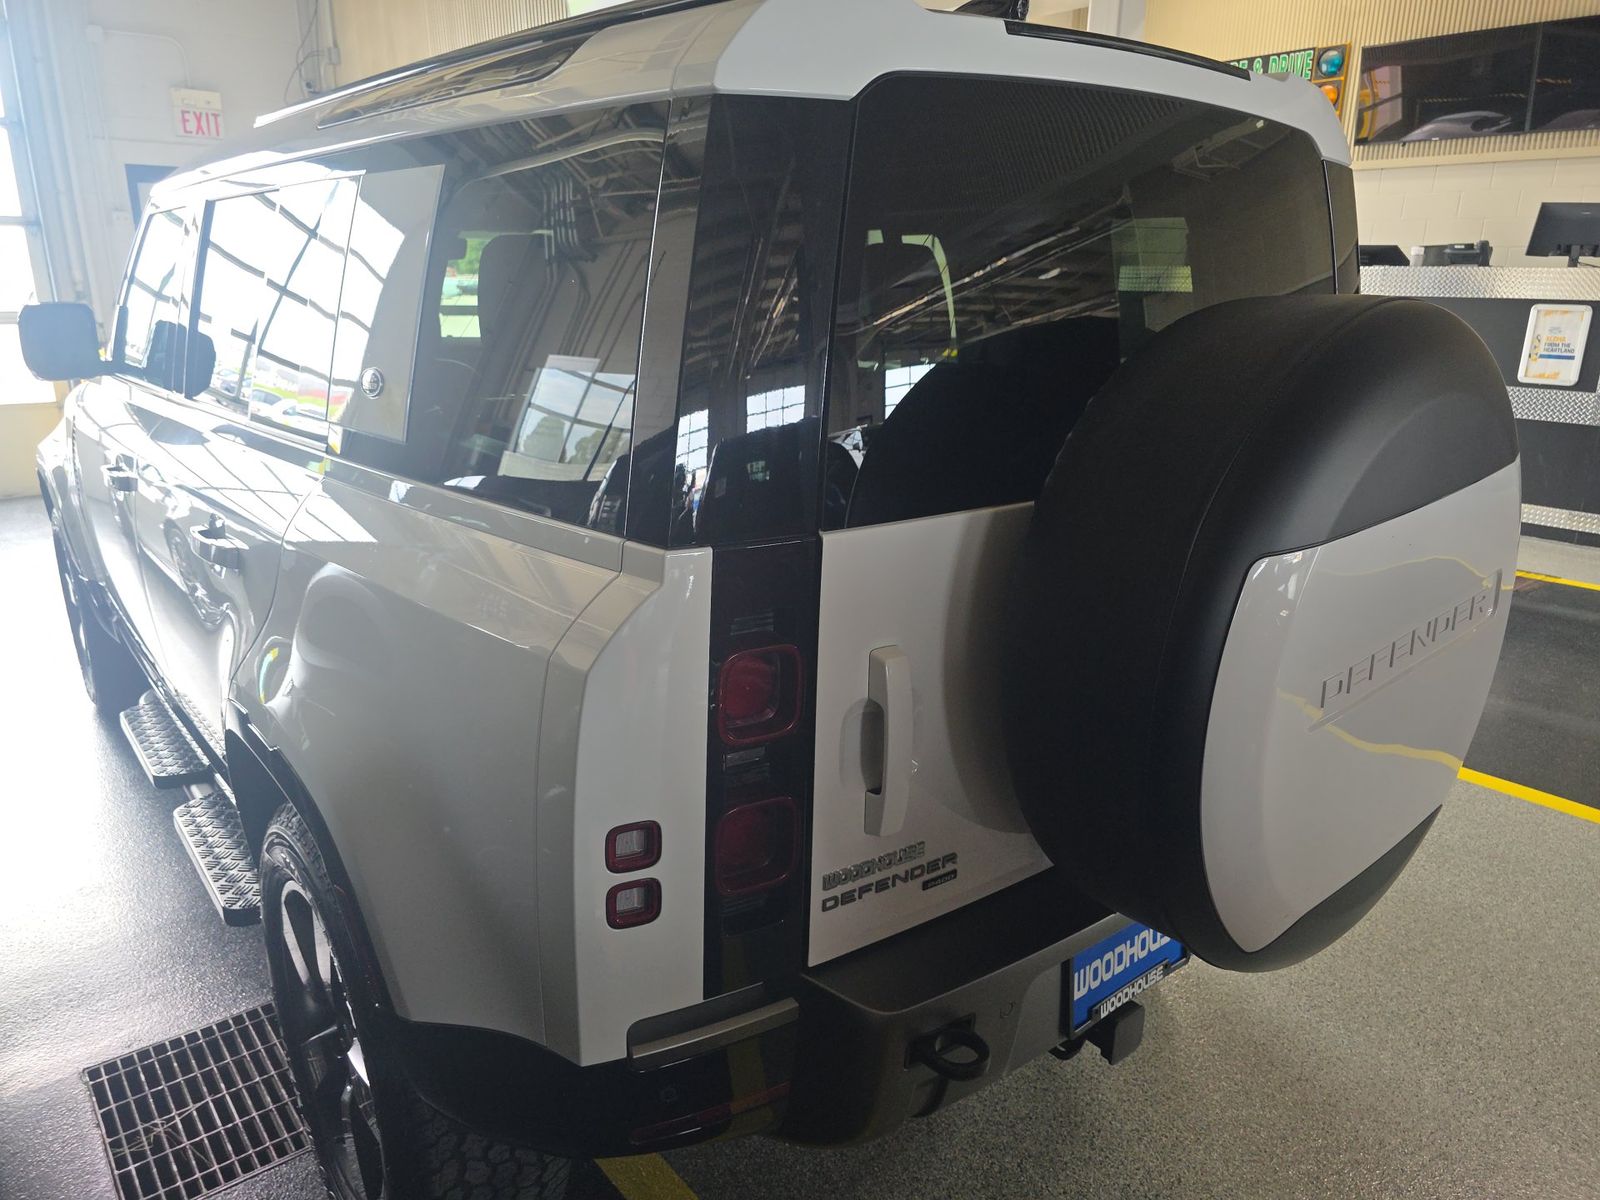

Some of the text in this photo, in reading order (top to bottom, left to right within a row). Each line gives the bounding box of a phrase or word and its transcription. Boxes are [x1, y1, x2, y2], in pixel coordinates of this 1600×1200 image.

[1268, 50, 1314, 80] DRIVE
[180, 109, 221, 137] EXIT
[1320, 589, 1487, 708] DEFENDER
[821, 852, 959, 912] DEFENDER
[1100, 965, 1164, 1019] WOODHOUSE
